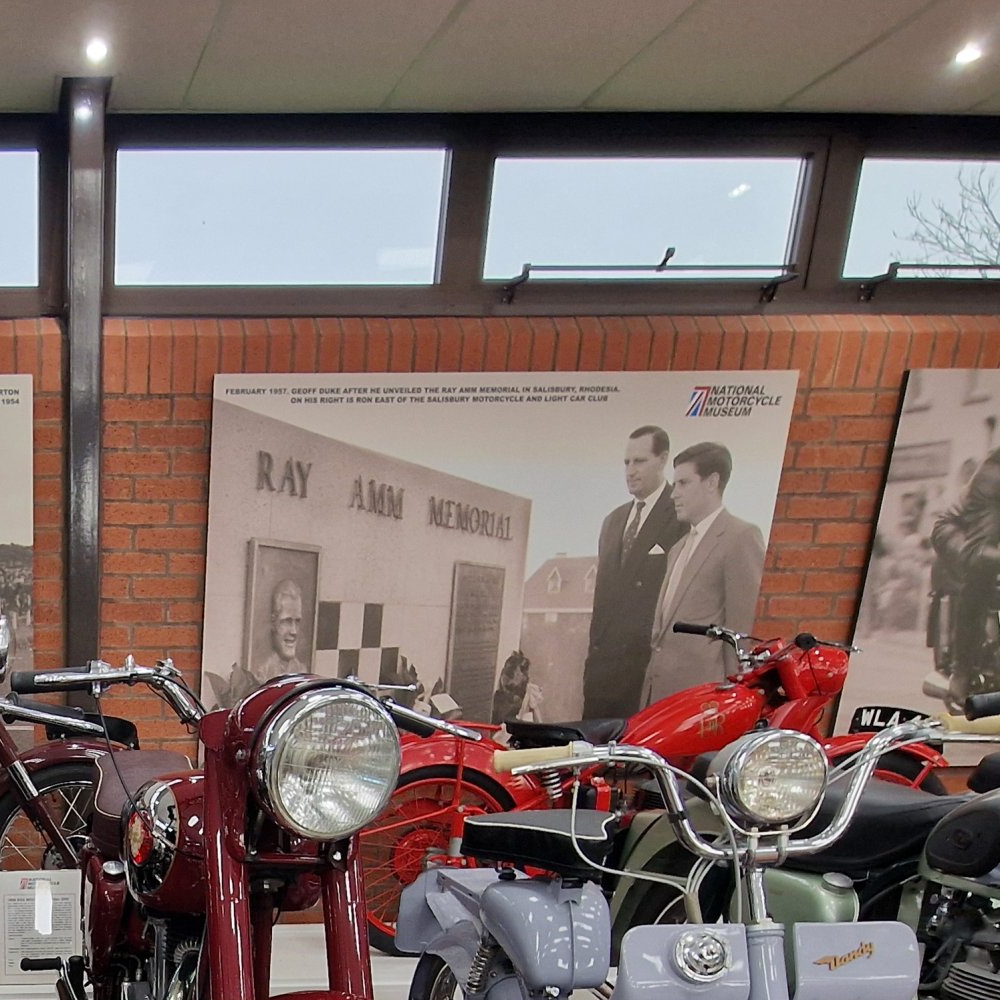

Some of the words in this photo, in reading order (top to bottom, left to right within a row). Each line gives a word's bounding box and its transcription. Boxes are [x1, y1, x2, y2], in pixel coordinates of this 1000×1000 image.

[711, 385, 765, 395] NATIONAL
[707, 396, 782, 406] MOTORCYCLE
[703, 407, 752, 417] MUSEUM
[256, 450, 312, 498] RAY
[350, 475, 405, 520] AMM
[428, 496, 513, 540] MEMORIAL
[860, 708, 900, 728] WLA
